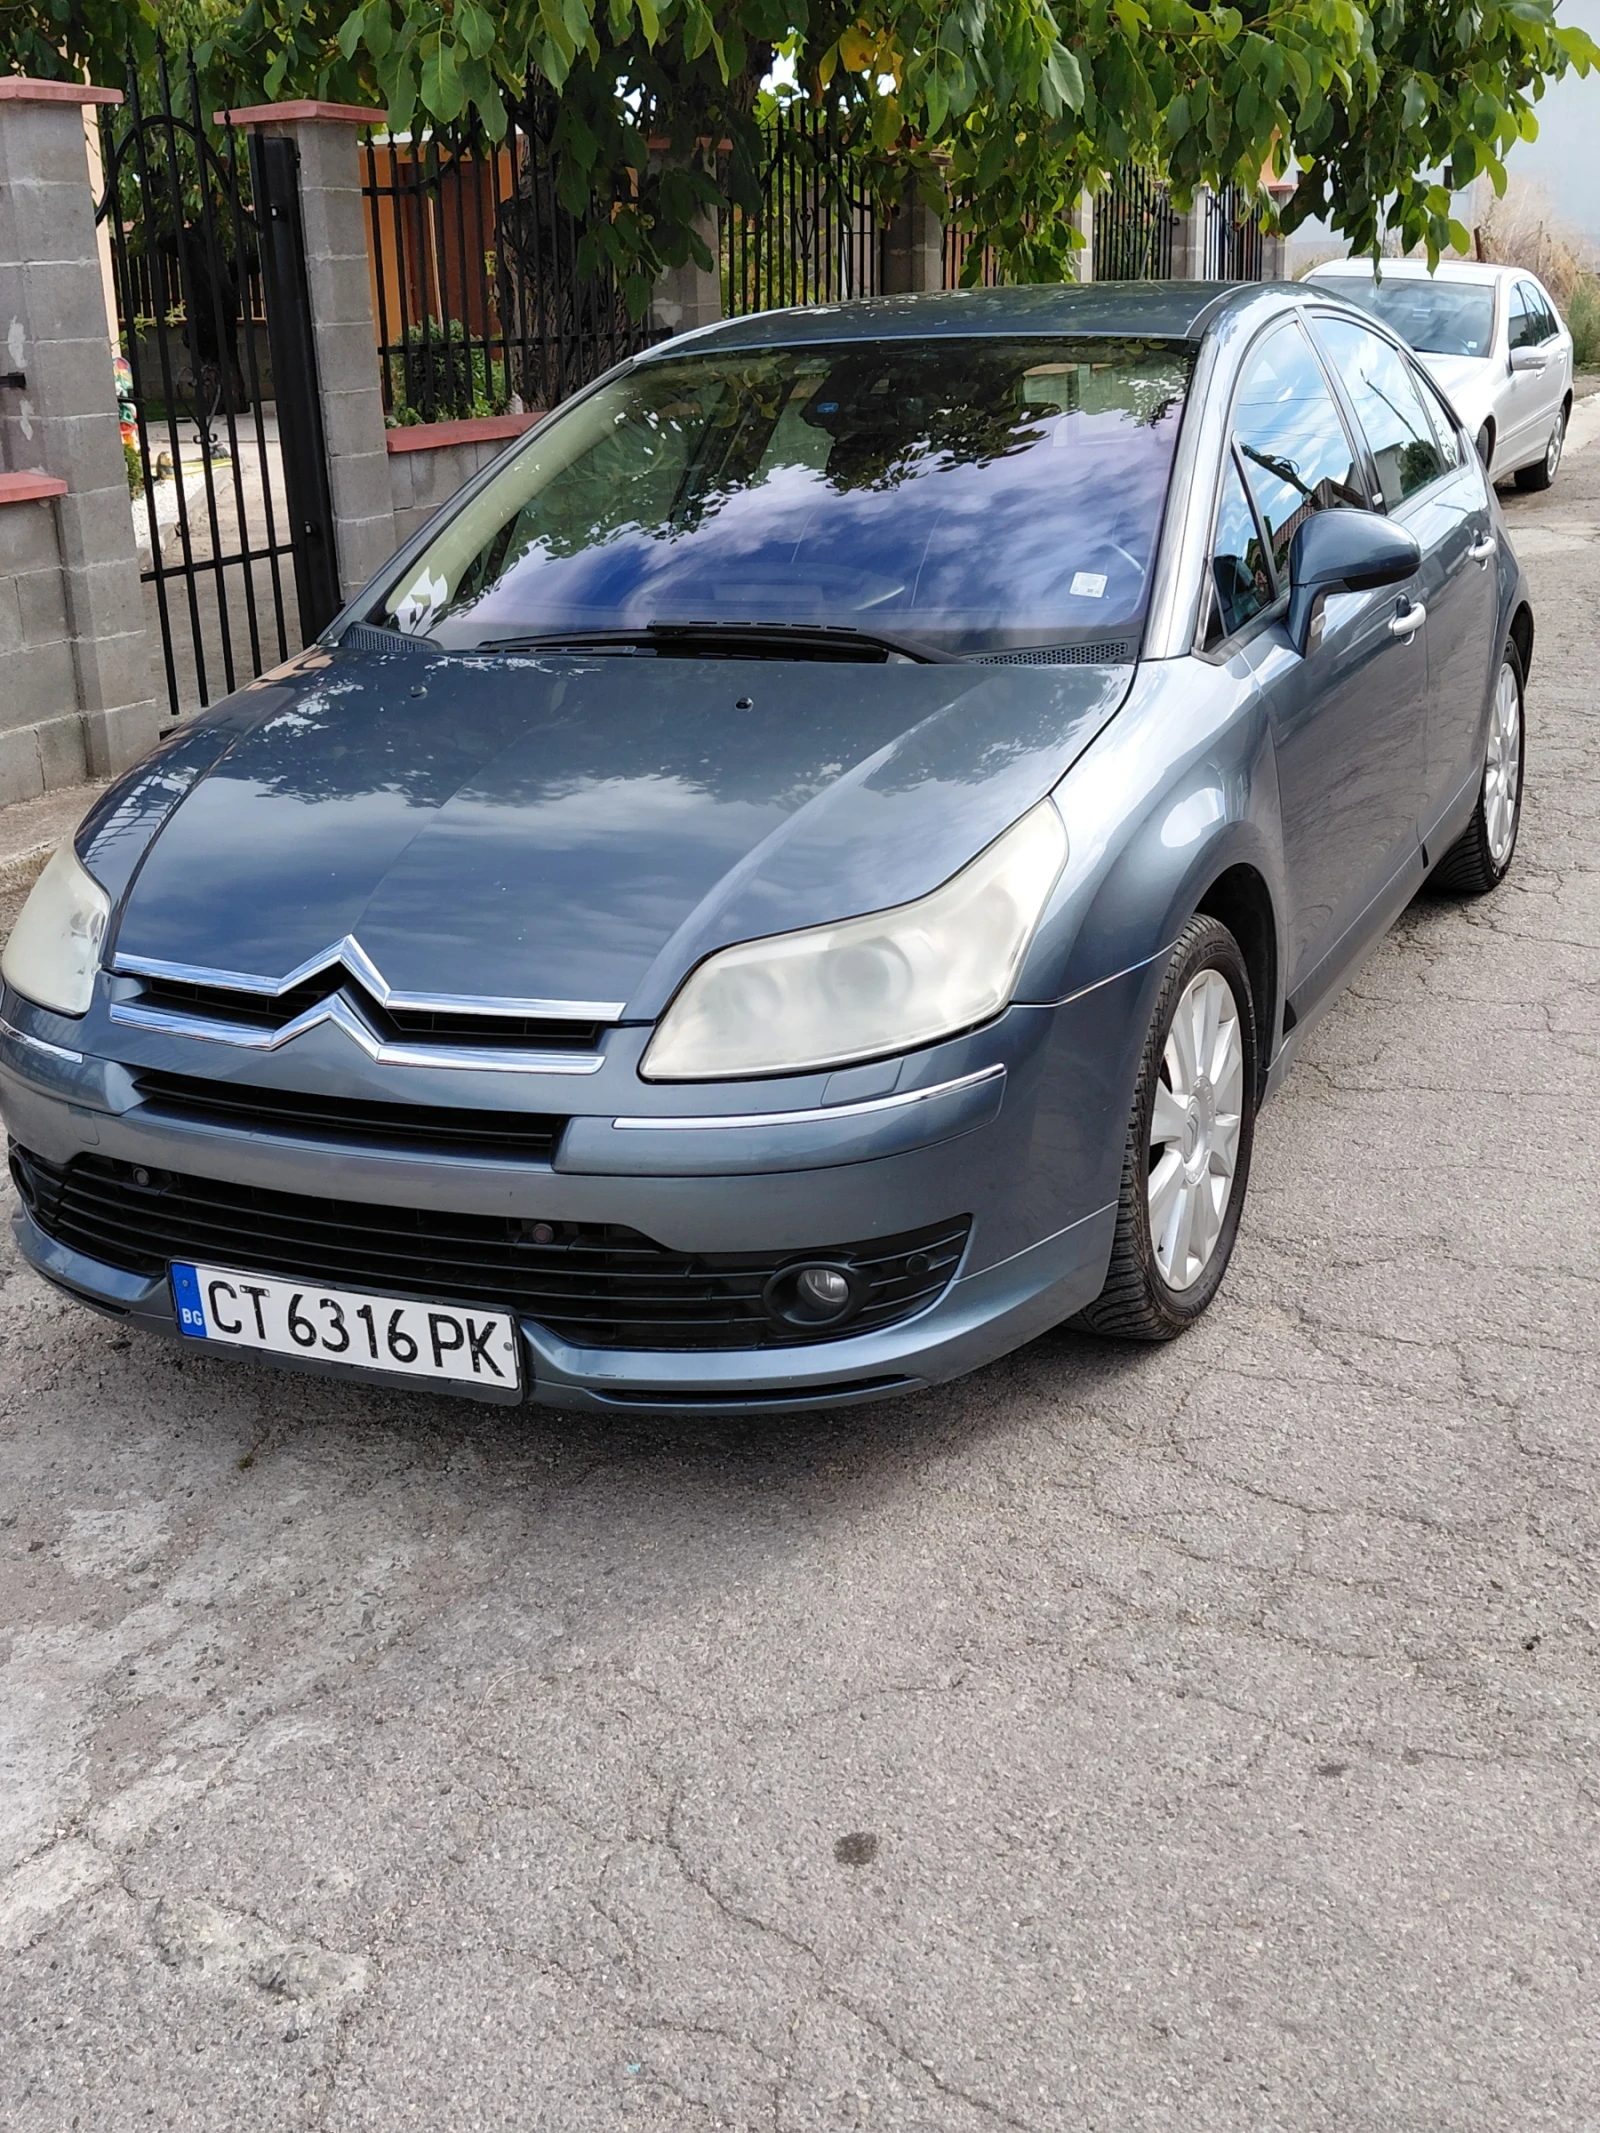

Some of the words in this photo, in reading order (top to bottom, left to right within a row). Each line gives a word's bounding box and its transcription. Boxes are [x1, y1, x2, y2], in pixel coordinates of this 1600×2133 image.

[182, 1308, 203, 1327] BG
[208, 1280, 270, 1340] CT
[288, 1293, 418, 1363] 6316
[428, 1312, 506, 1378] PK
